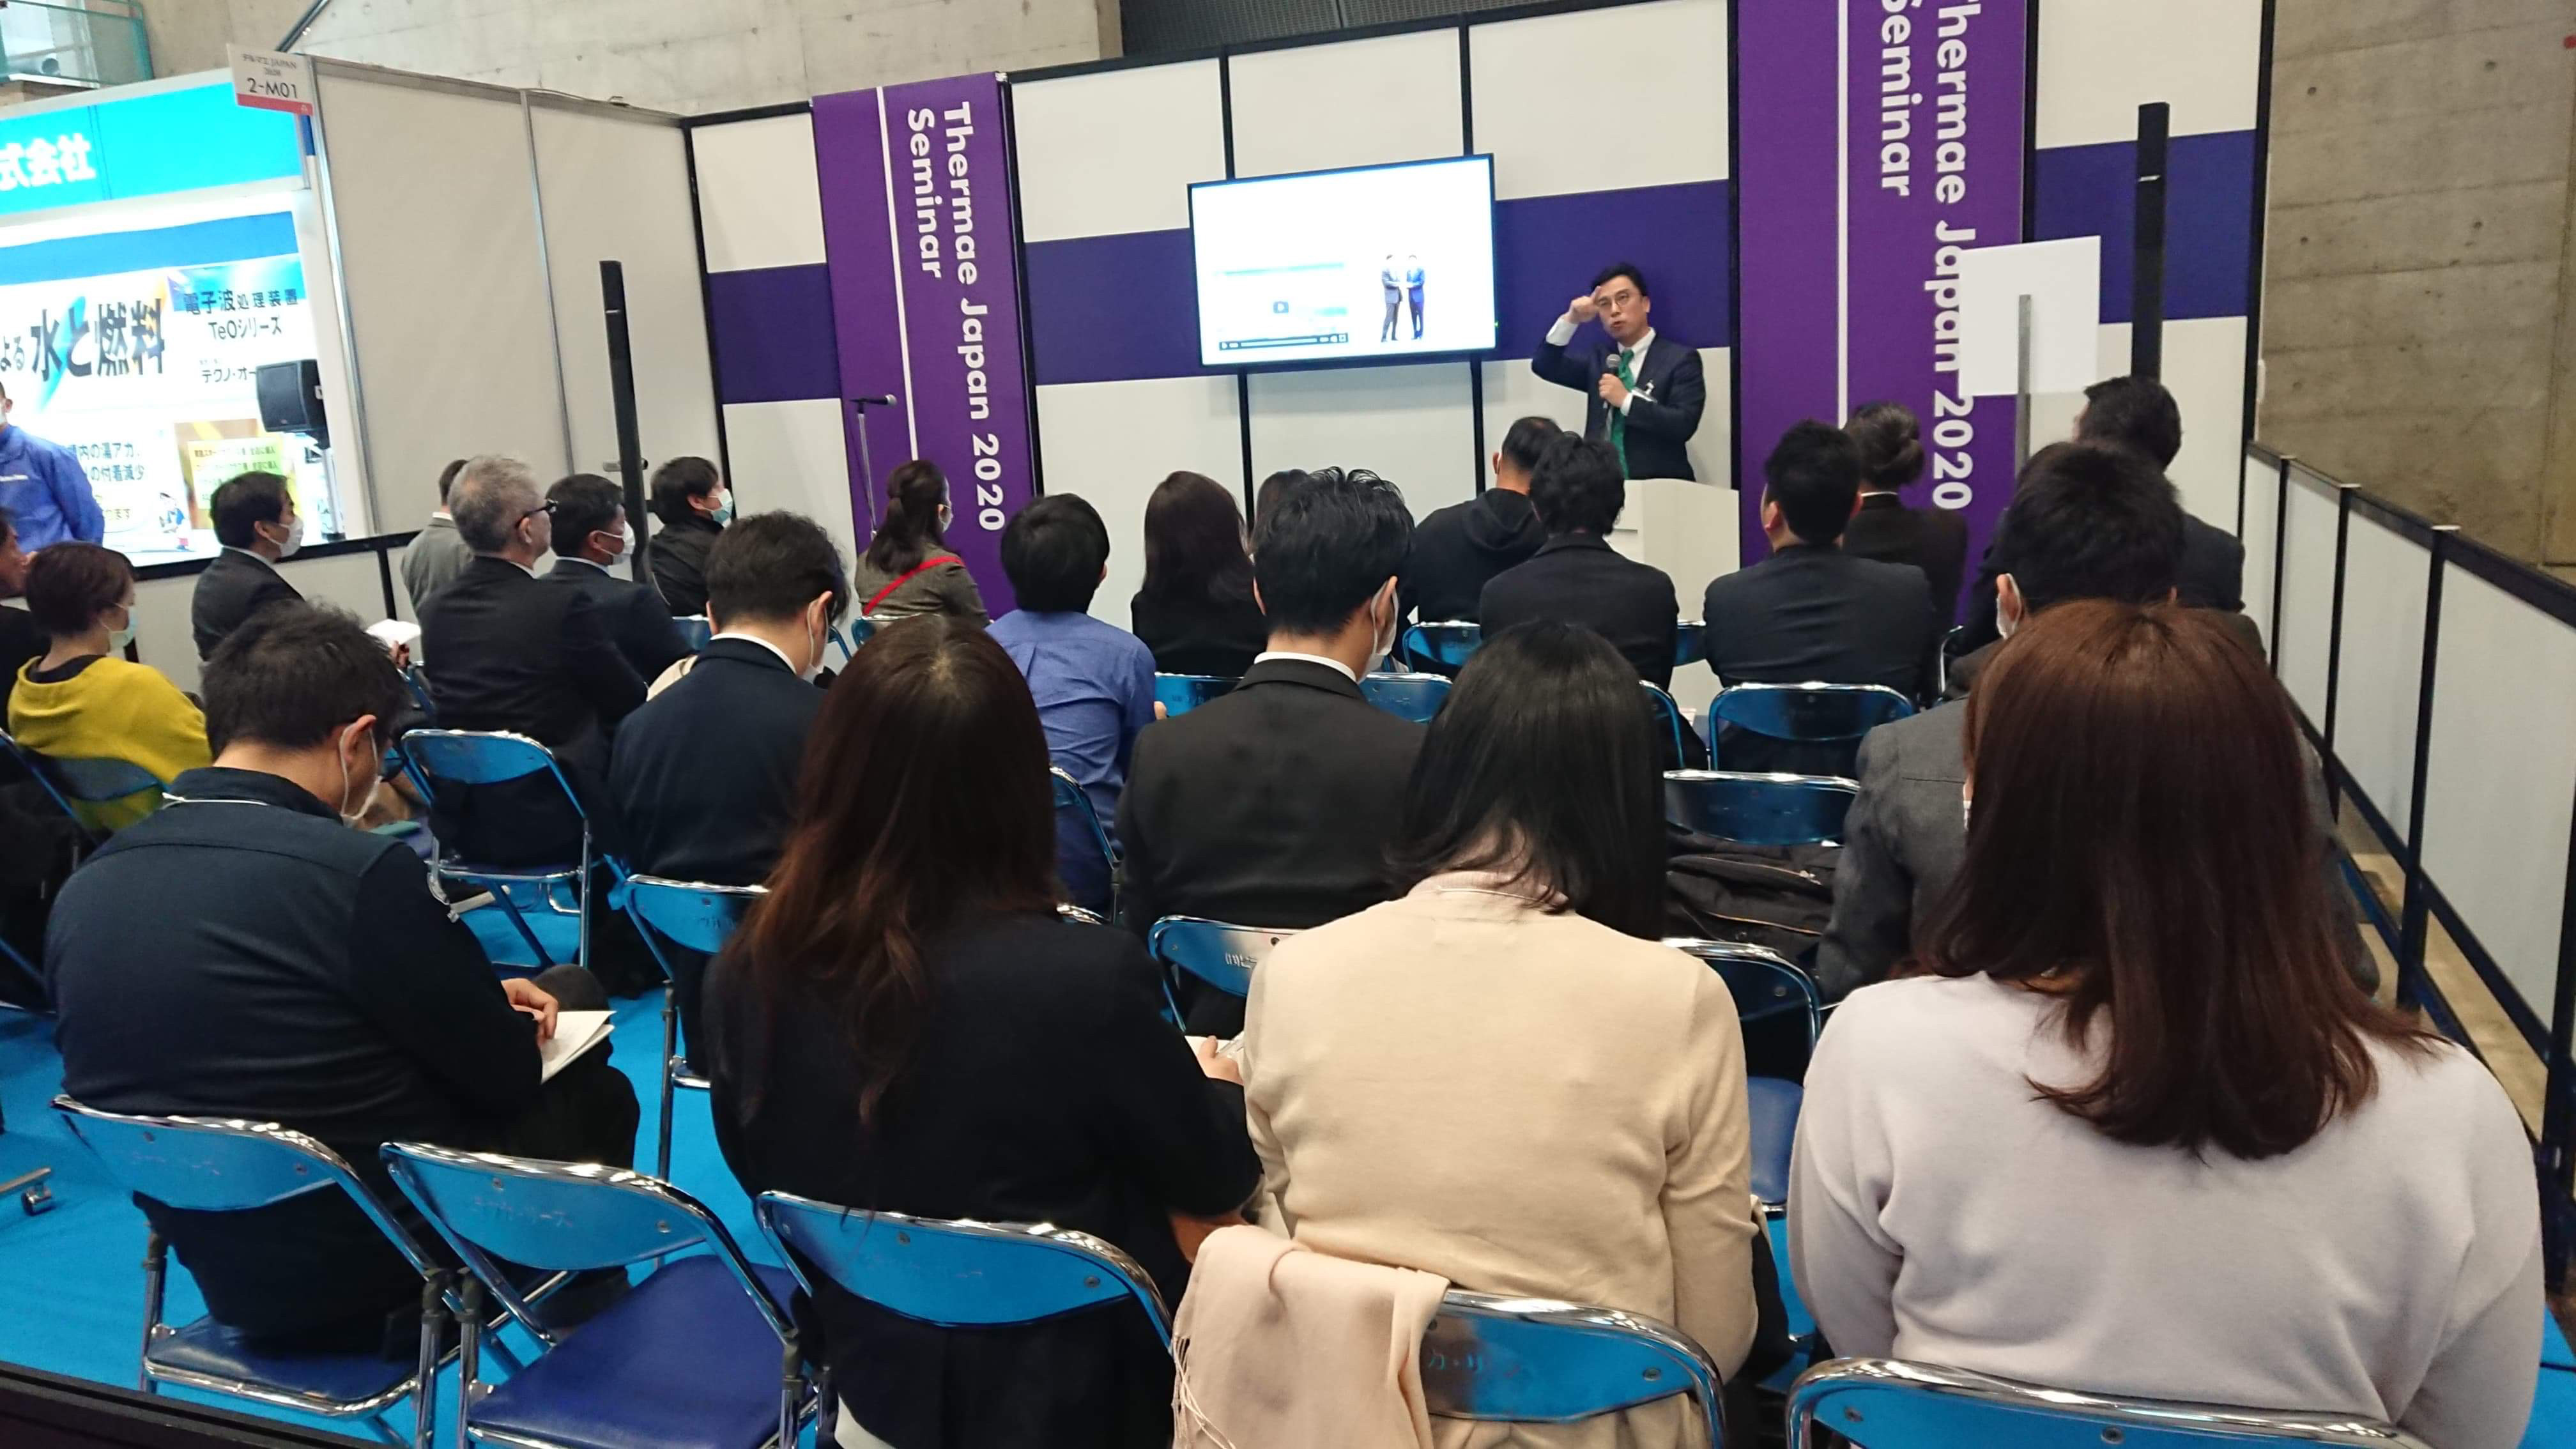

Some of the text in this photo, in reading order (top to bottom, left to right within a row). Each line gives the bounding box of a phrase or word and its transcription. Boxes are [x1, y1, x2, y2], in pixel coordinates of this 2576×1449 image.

[247, 77, 298, 98] 2-M01
[1936, 0, 1981, 204] hermae
[907, 108, 942, 279] Seminar
[944, 101, 1006, 531] Thermae Japan 2020
[1933, 390, 1974, 510] 2020
